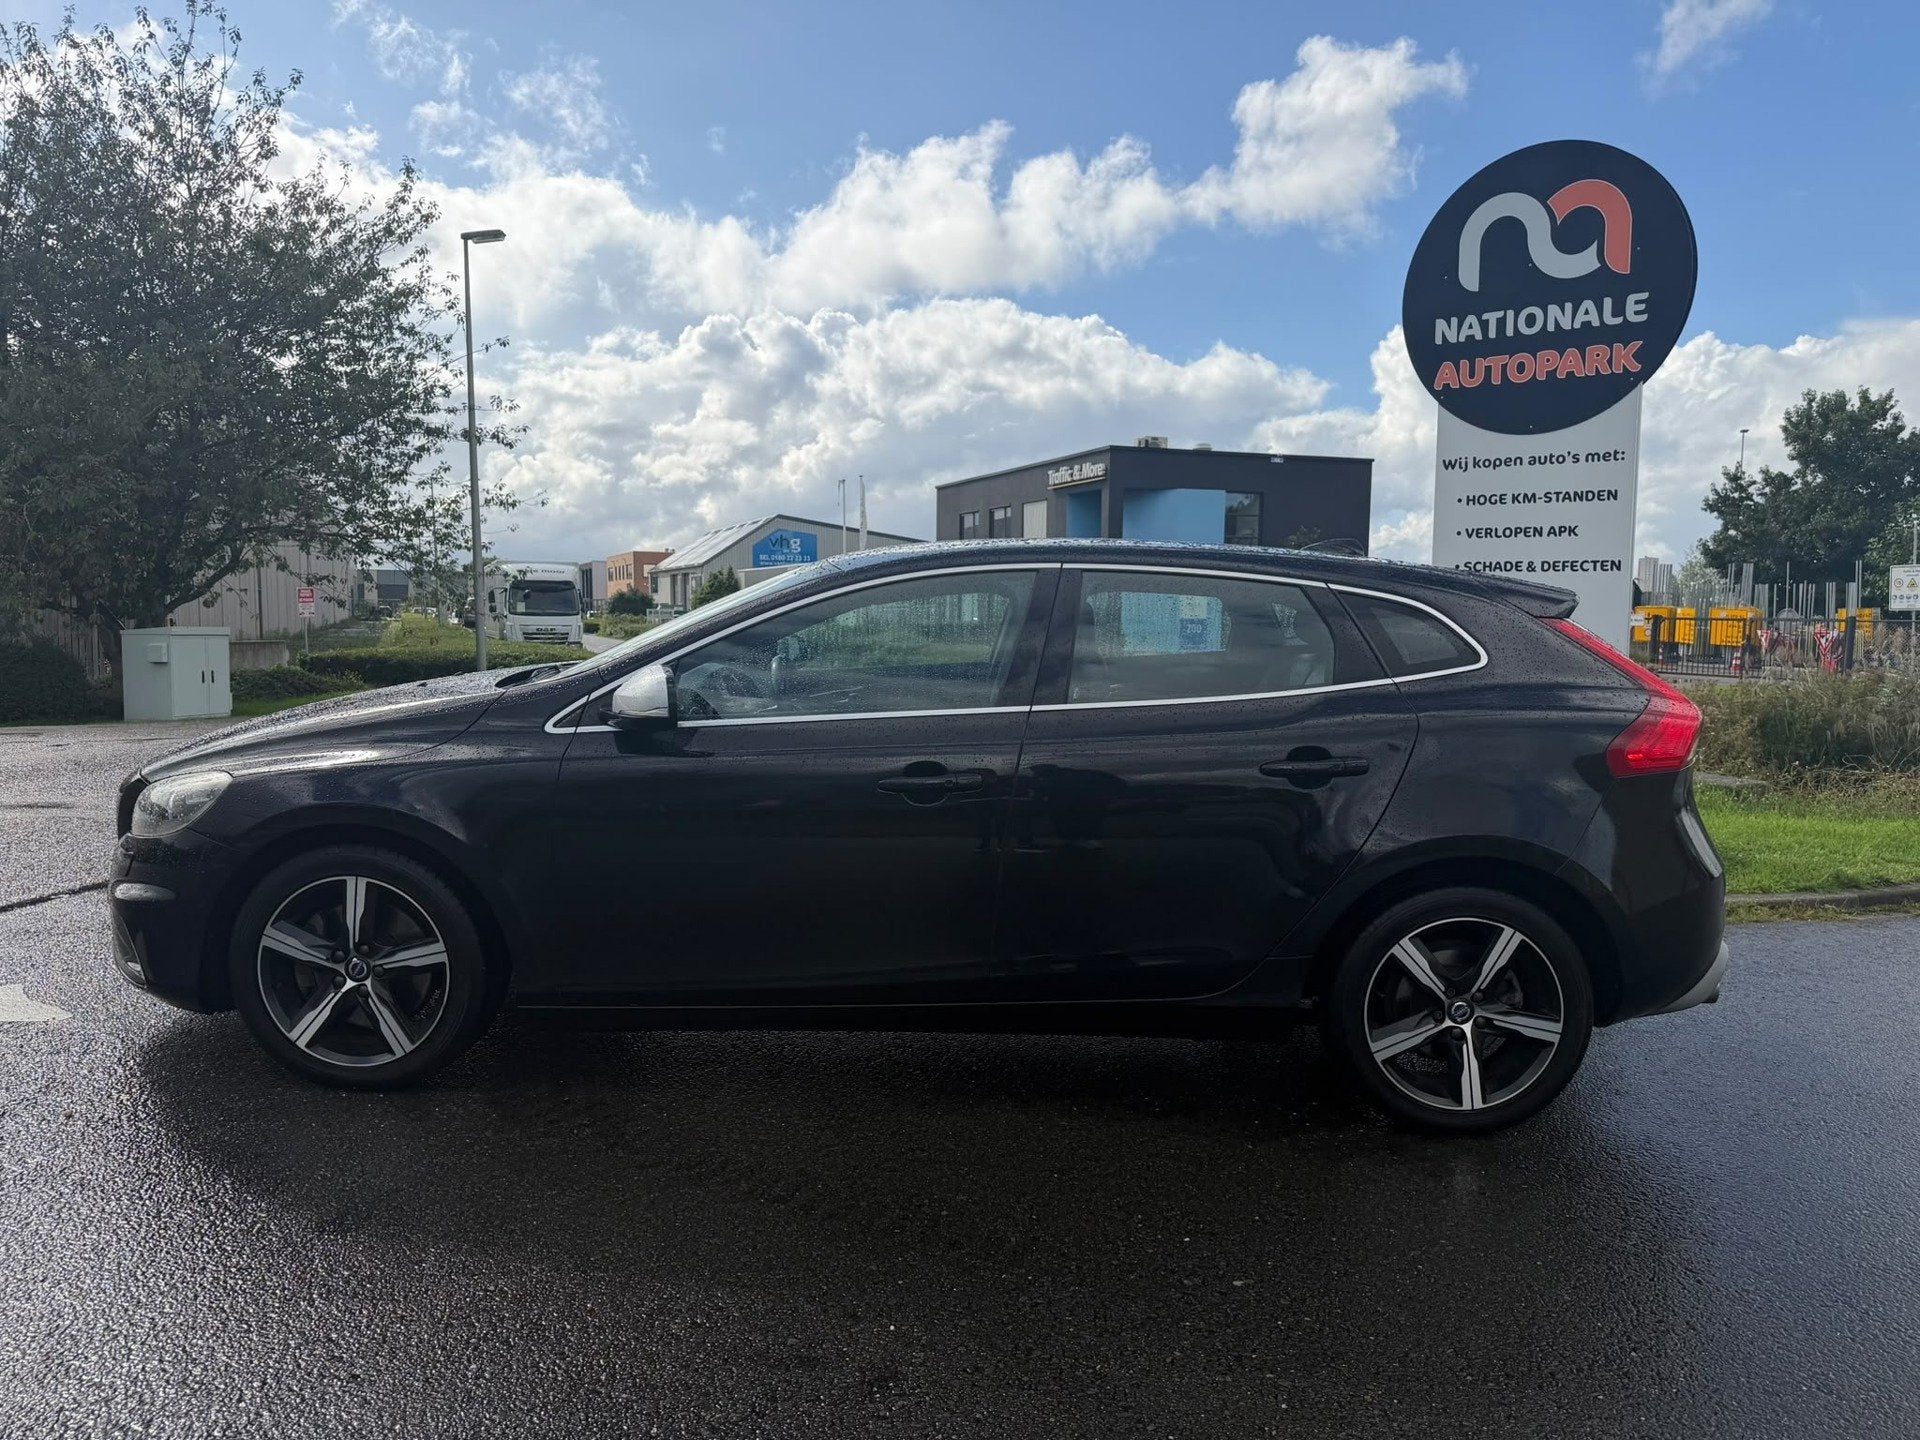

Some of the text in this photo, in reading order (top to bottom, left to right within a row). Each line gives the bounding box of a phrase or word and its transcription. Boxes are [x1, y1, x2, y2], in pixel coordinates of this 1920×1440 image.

[1434, 291, 1650, 345] NATIONALE
[1433, 340, 1644, 390] AUTOPARK
[1442, 449, 1626, 473] Wij kopen auto's met:
[1048, 462, 1105, 485] Traffic & More
[1466, 489, 1618, 506] HOGE KM-STANDEN
[1465, 525, 1579, 539] VERLOPEN APK
[769, 534, 801, 553] vhg
[1463, 559, 1622, 573] SCHADE & DEFECTEN
[1186, 624, 1202, 633] 200
